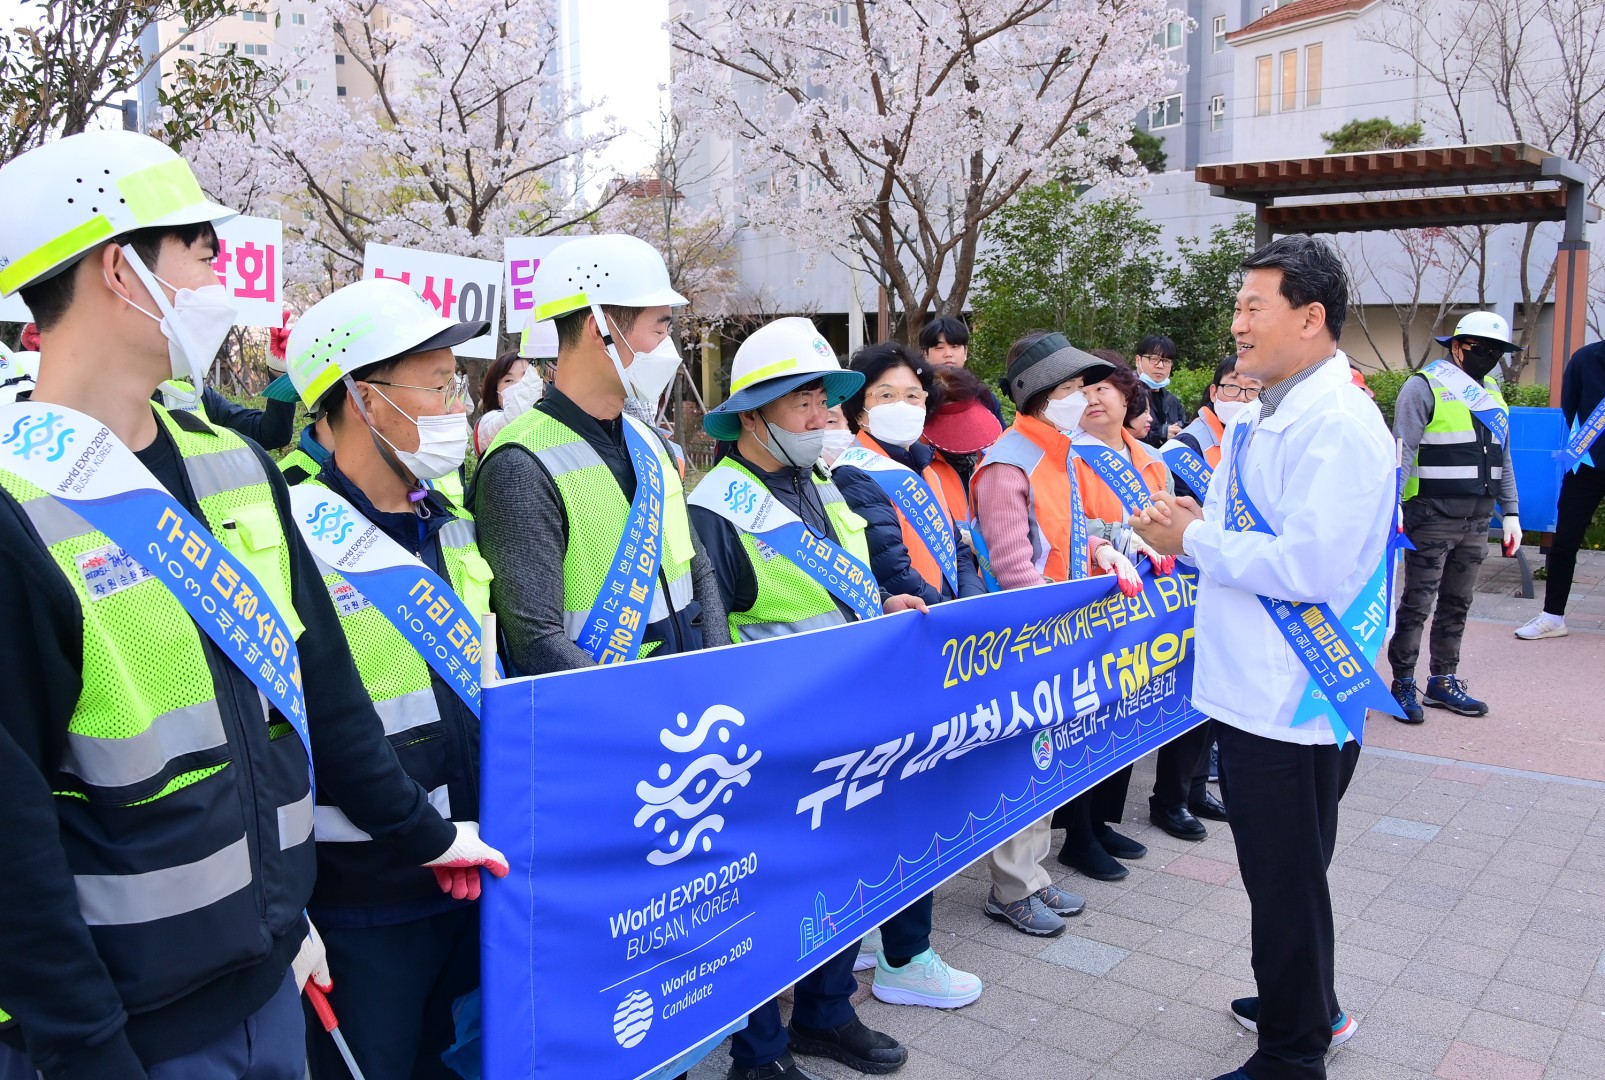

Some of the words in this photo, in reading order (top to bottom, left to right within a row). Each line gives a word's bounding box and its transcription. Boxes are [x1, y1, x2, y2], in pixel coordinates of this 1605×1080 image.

[374, 268, 496, 336] 산이
[56, 467, 80, 493] World
[75, 446, 95, 470] EXPO
[91, 427, 109, 449] 2030
[92, 442, 114, 467] KOREA
[645, 453, 661, 494] 구민
[1099, 450, 1124, 472] 구민
[1179, 451, 1203, 473] 구민
[336, 549, 353, 567] World
[350, 535, 367, 551] EXPO
[636, 494, 661, 578] 대청소의
[901, 476, 928, 506] 구민
[923, 503, 955, 557] 대청소의
[157, 506, 212, 571] 구민
[210, 559, 290, 667] 대청소의
[602, 579, 625, 613] 부산
[628, 577, 649, 605] 날
[800, 529, 833, 561] 구민
[832, 553, 881, 610] 대청소의
[147, 542, 289, 699] 2030세계박람회
[397, 604, 481, 706] 2030세계박
[408, 577, 454, 627] 구민
[446, 617, 482, 665] 대청
[941, 627, 1012, 689] 2030
[1010, 592, 1156, 663] 부산세계박람회
[1287, 621, 1338, 687] 응원합니다
[1300, 605, 1362, 678] 클린데이
[796, 732, 915, 830] 구민
[1072, 660, 1101, 719] 날
[608, 892, 665, 940] World
[669, 871, 717, 913] EXPO
[719, 851, 758, 890] 2030
[625, 913, 689, 961] BUSAN,
[690, 887, 740, 930] KOREA
[660, 967, 697, 997] World
[699, 954, 728, 981] Expo
[729, 937, 753, 962] 2030
[662, 982, 714, 1020] Candidate
